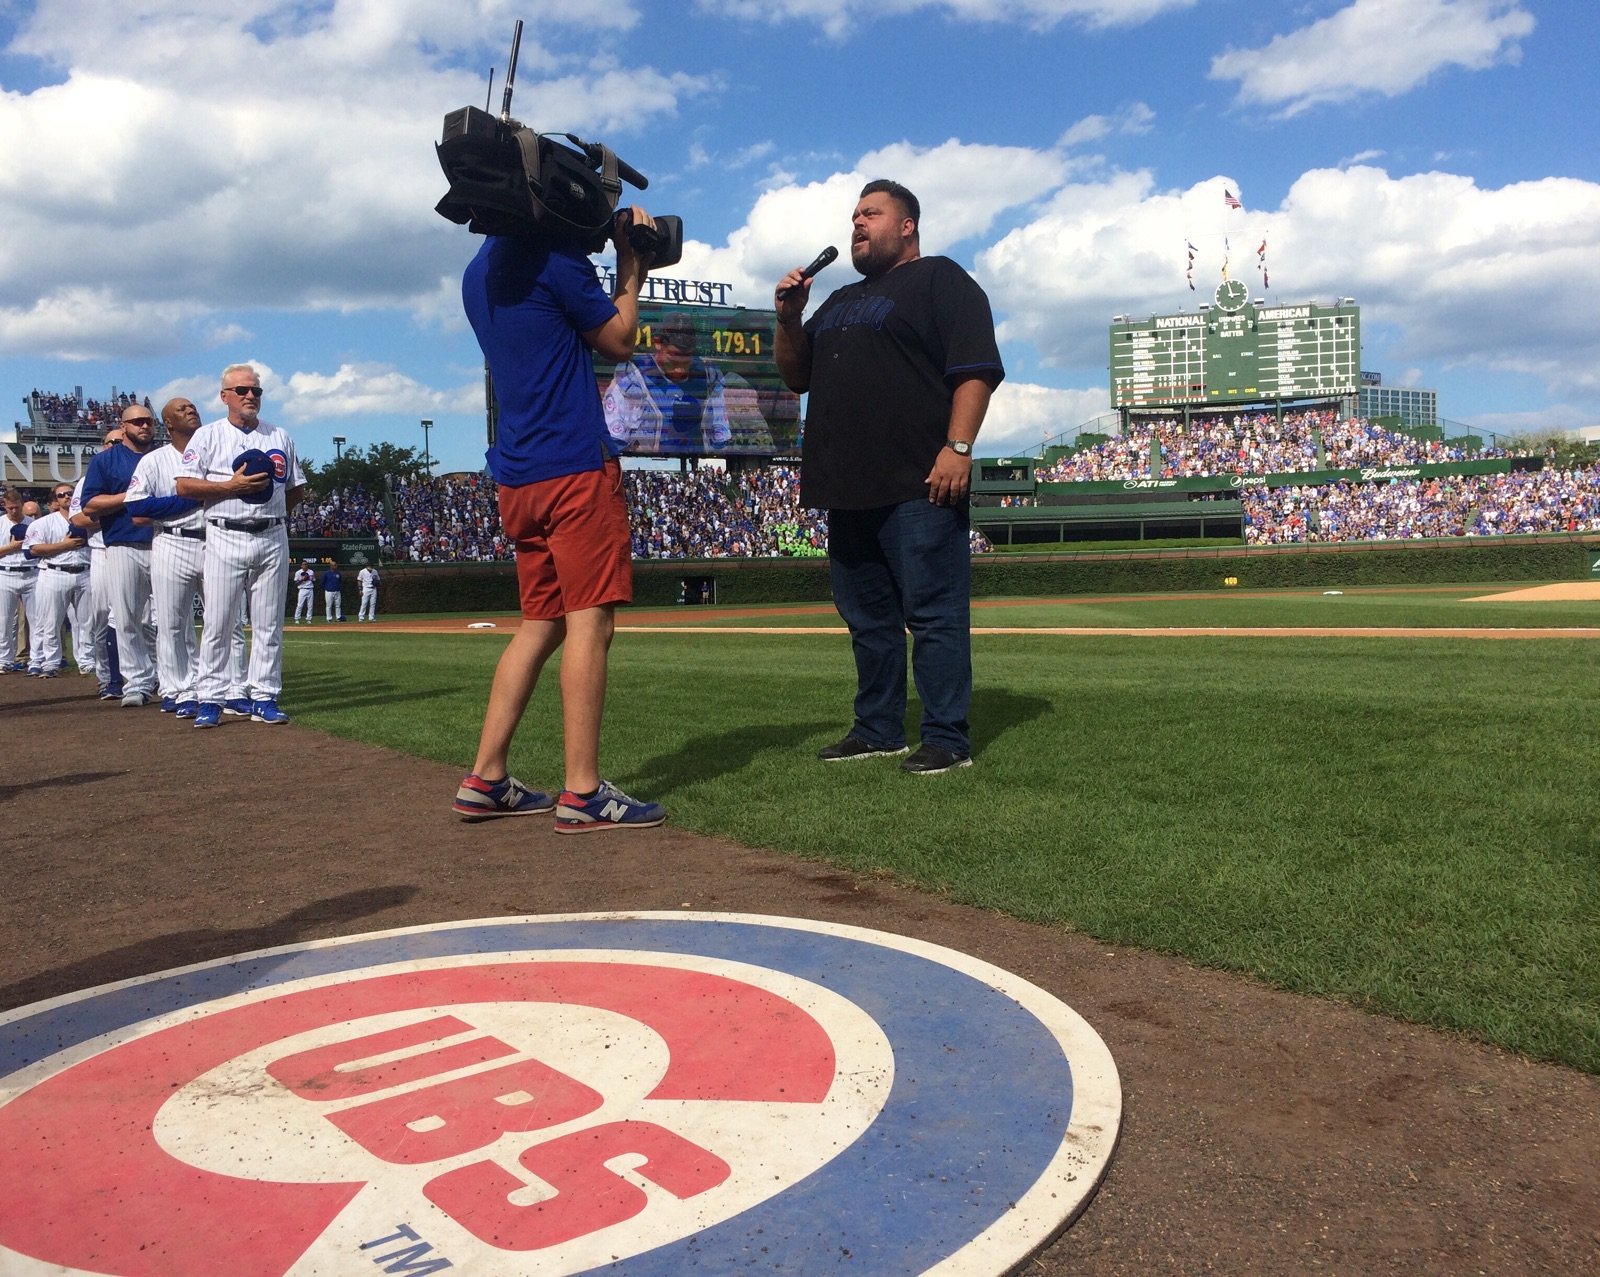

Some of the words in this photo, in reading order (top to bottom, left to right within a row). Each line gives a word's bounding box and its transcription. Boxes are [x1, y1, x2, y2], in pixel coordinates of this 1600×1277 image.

[1258, 307, 1310, 321] AMERICAN
[1156, 316, 1207, 329] NATIONAL
[712, 330, 760, 355] 179.1
[1360, 467, 1421, 480] Budweiser
[1137, 480, 1159, 488] ATI
[1242, 475, 1266, 486] pepsi
[1224, 576, 1238, 585] 400
[600, 799, 628, 822] N
